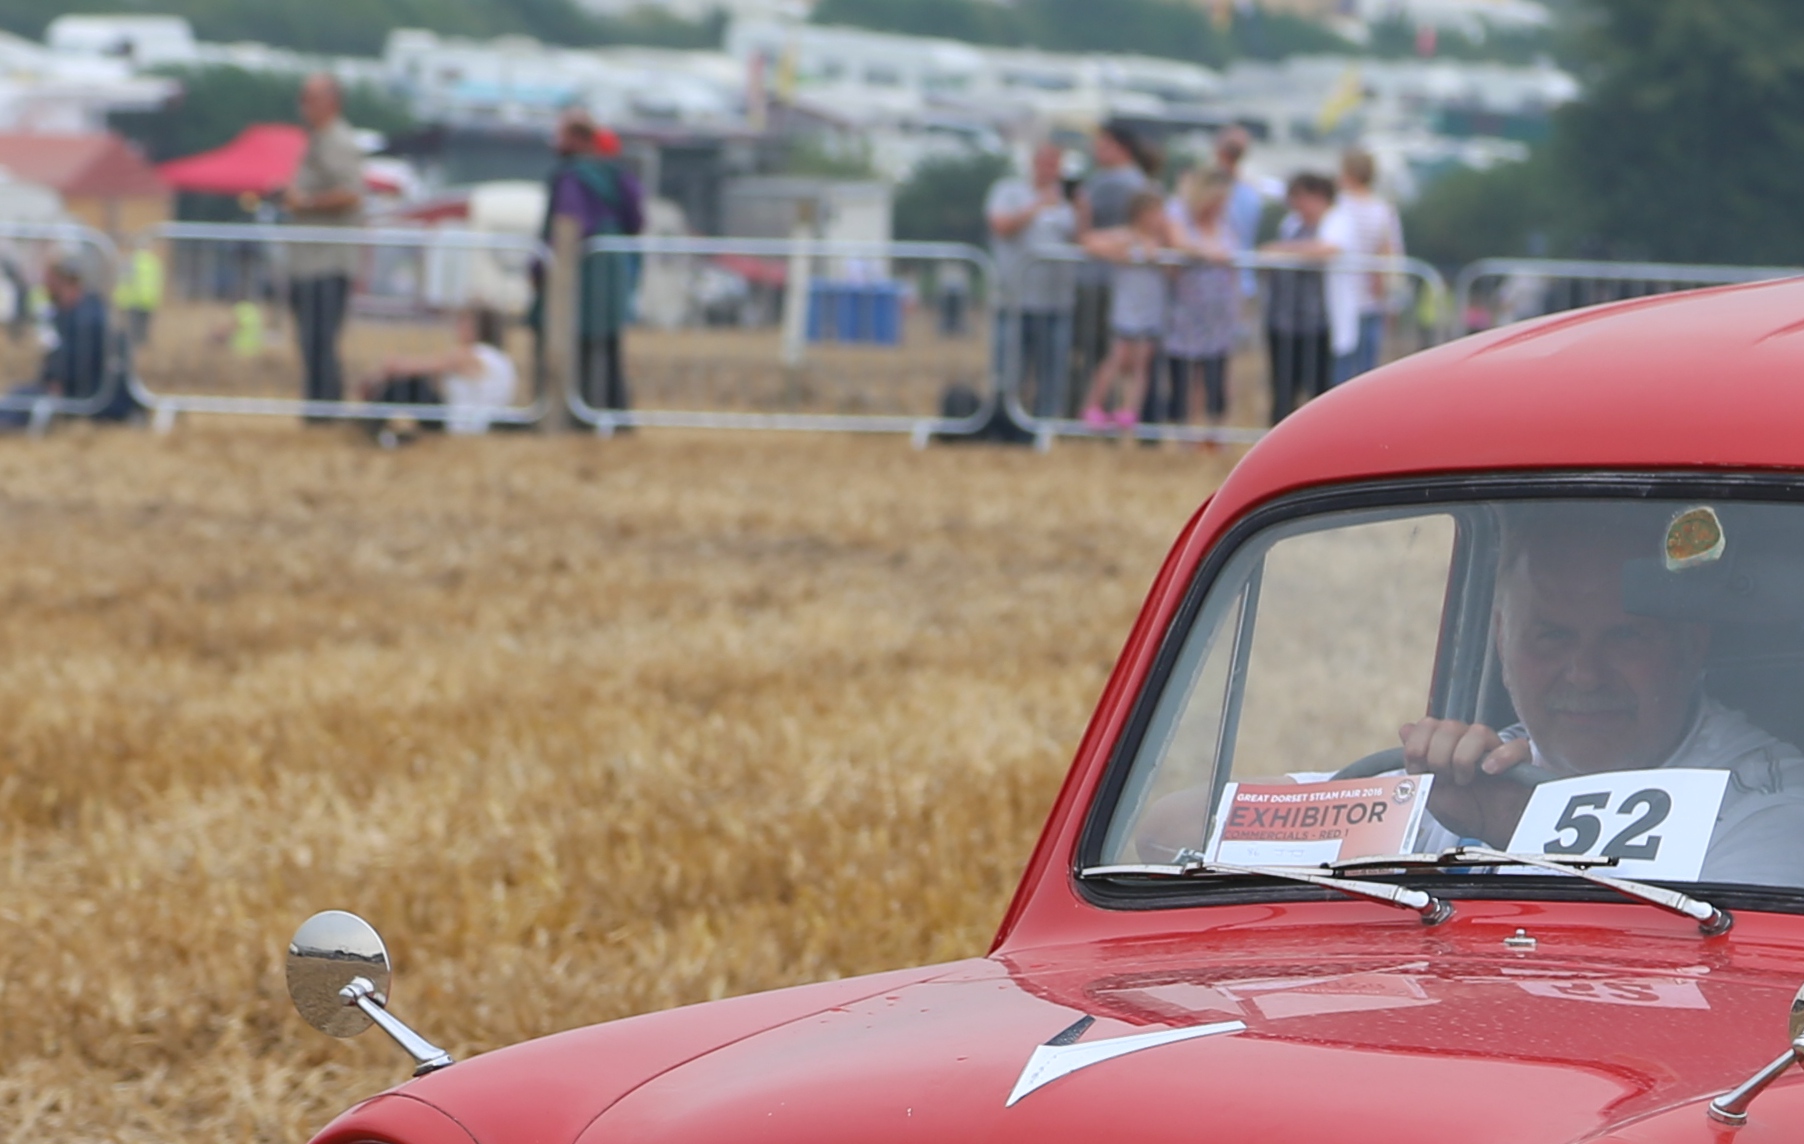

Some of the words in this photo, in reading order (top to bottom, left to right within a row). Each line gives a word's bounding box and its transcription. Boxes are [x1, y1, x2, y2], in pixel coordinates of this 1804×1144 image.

[1237, 793, 1269, 803] GREAT
[1271, 793, 1307, 803] DORSET
[1310, 791, 1339, 802] STEAM
[1340, 789, 1361, 800] FAIR
[1229, 801, 1388, 828] EXHIBITOR
[1543, 788, 1672, 861] 52
[1224, 829, 1308, 840] COMMERCIALS
[1319, 829, 1342, 839] RED
